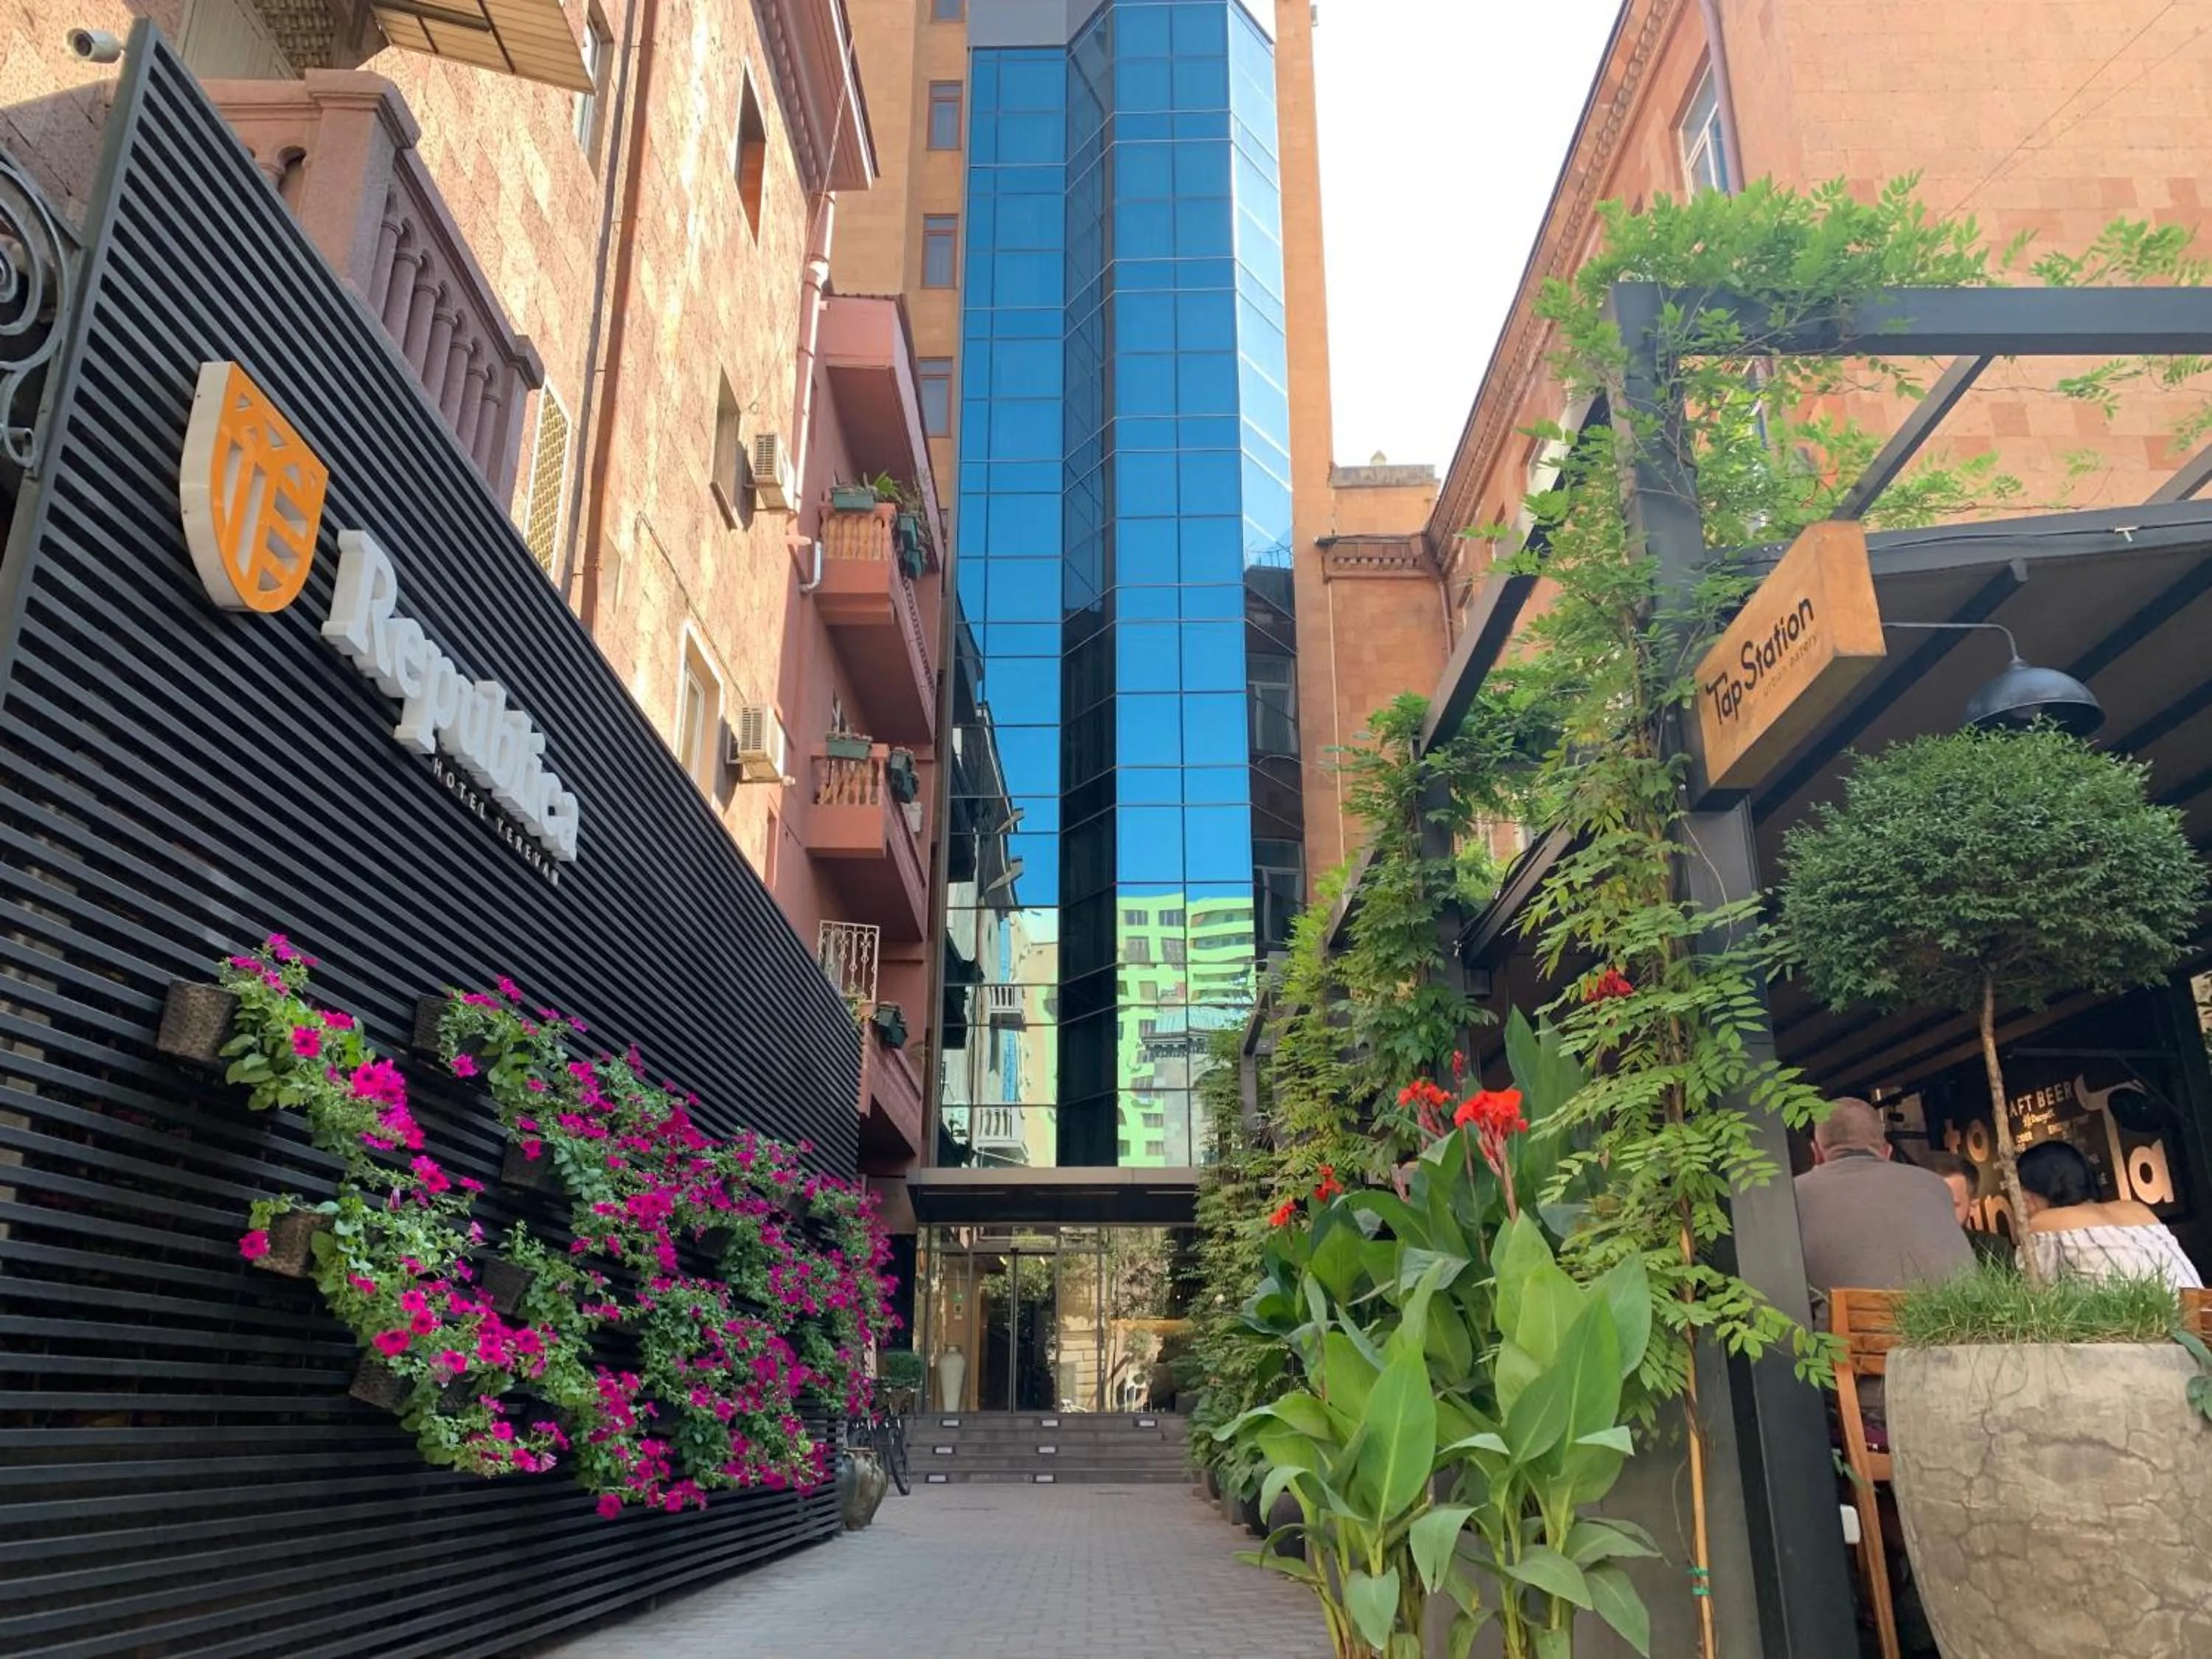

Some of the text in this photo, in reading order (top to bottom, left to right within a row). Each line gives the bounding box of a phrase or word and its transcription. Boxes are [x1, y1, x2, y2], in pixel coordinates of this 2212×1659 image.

[321, 529, 580, 861] Republica
[1706, 598, 1814, 725] Tap Station
[434, 758, 559, 885] HOTEL YEREVAN
[2036, 1081, 2073, 1108] BEER
